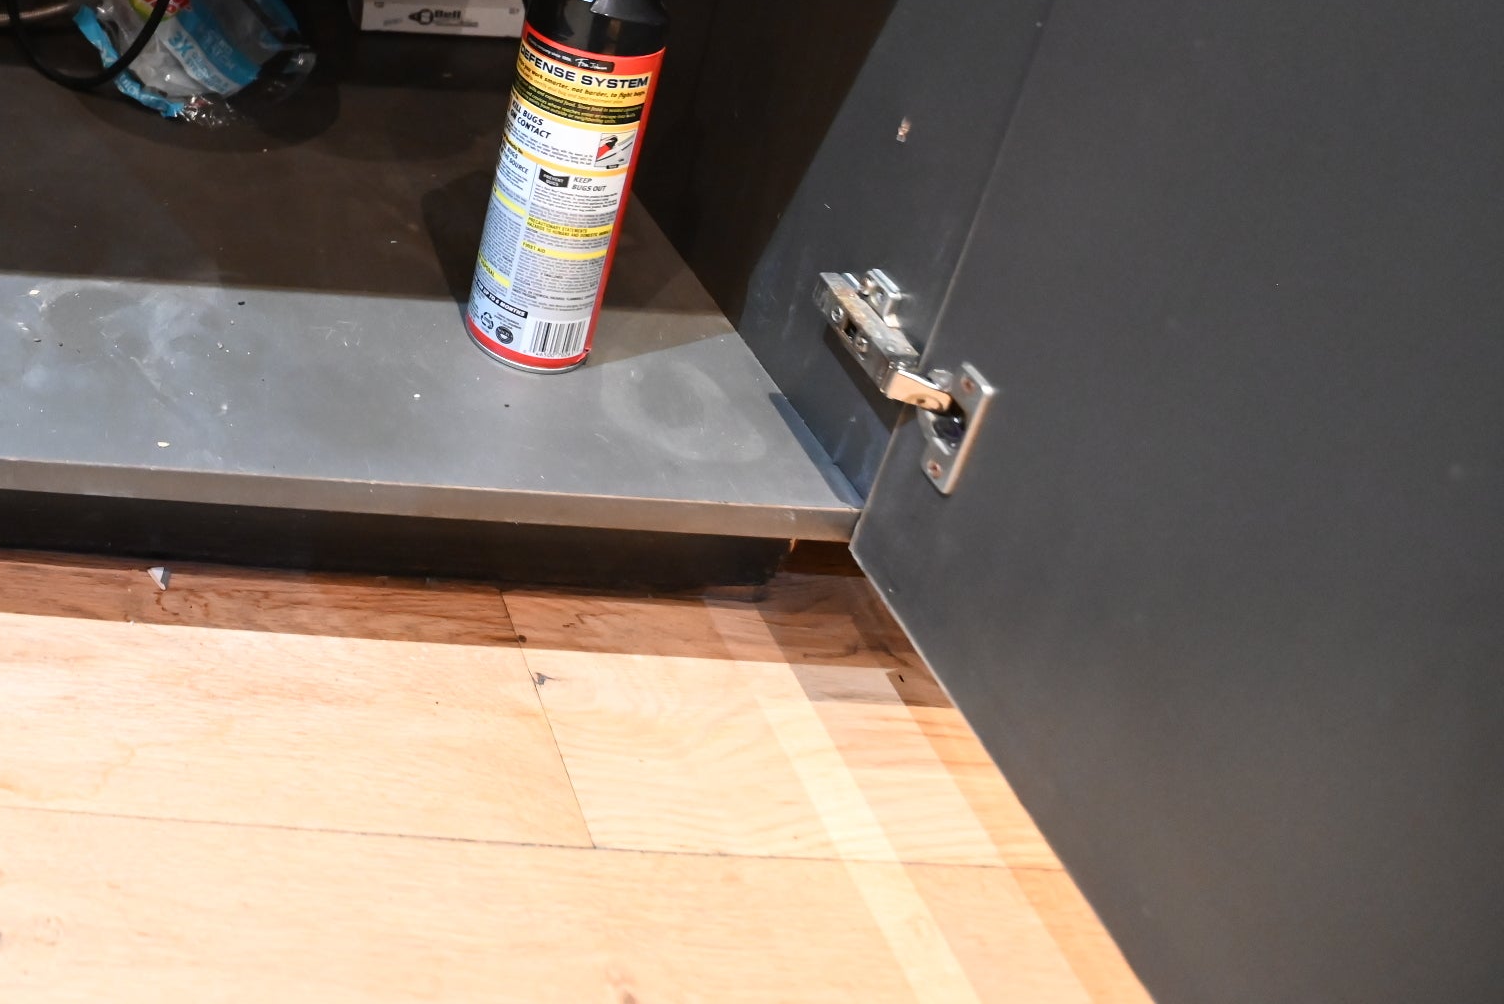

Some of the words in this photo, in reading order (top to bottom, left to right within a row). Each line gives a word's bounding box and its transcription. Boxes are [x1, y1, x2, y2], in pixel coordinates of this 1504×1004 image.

[520, 44, 576, 82] DEFENSE
[581, 75, 649, 89] SYSTEM
[531, 70, 544, 79] work
[544, 77, 570, 91] smarter,
[512, 99, 522, 114] KILL
[522, 109, 544, 126] BUGS
[517, 116, 551, 139] CONTACT
[509, 158, 529, 174] SOURCE
[571, 184, 592, 192] BUGS
[573, 176, 593, 184] KEEP
[522, 241, 536, 250] FIRST
[499, 301, 525, 316] MONTHS
